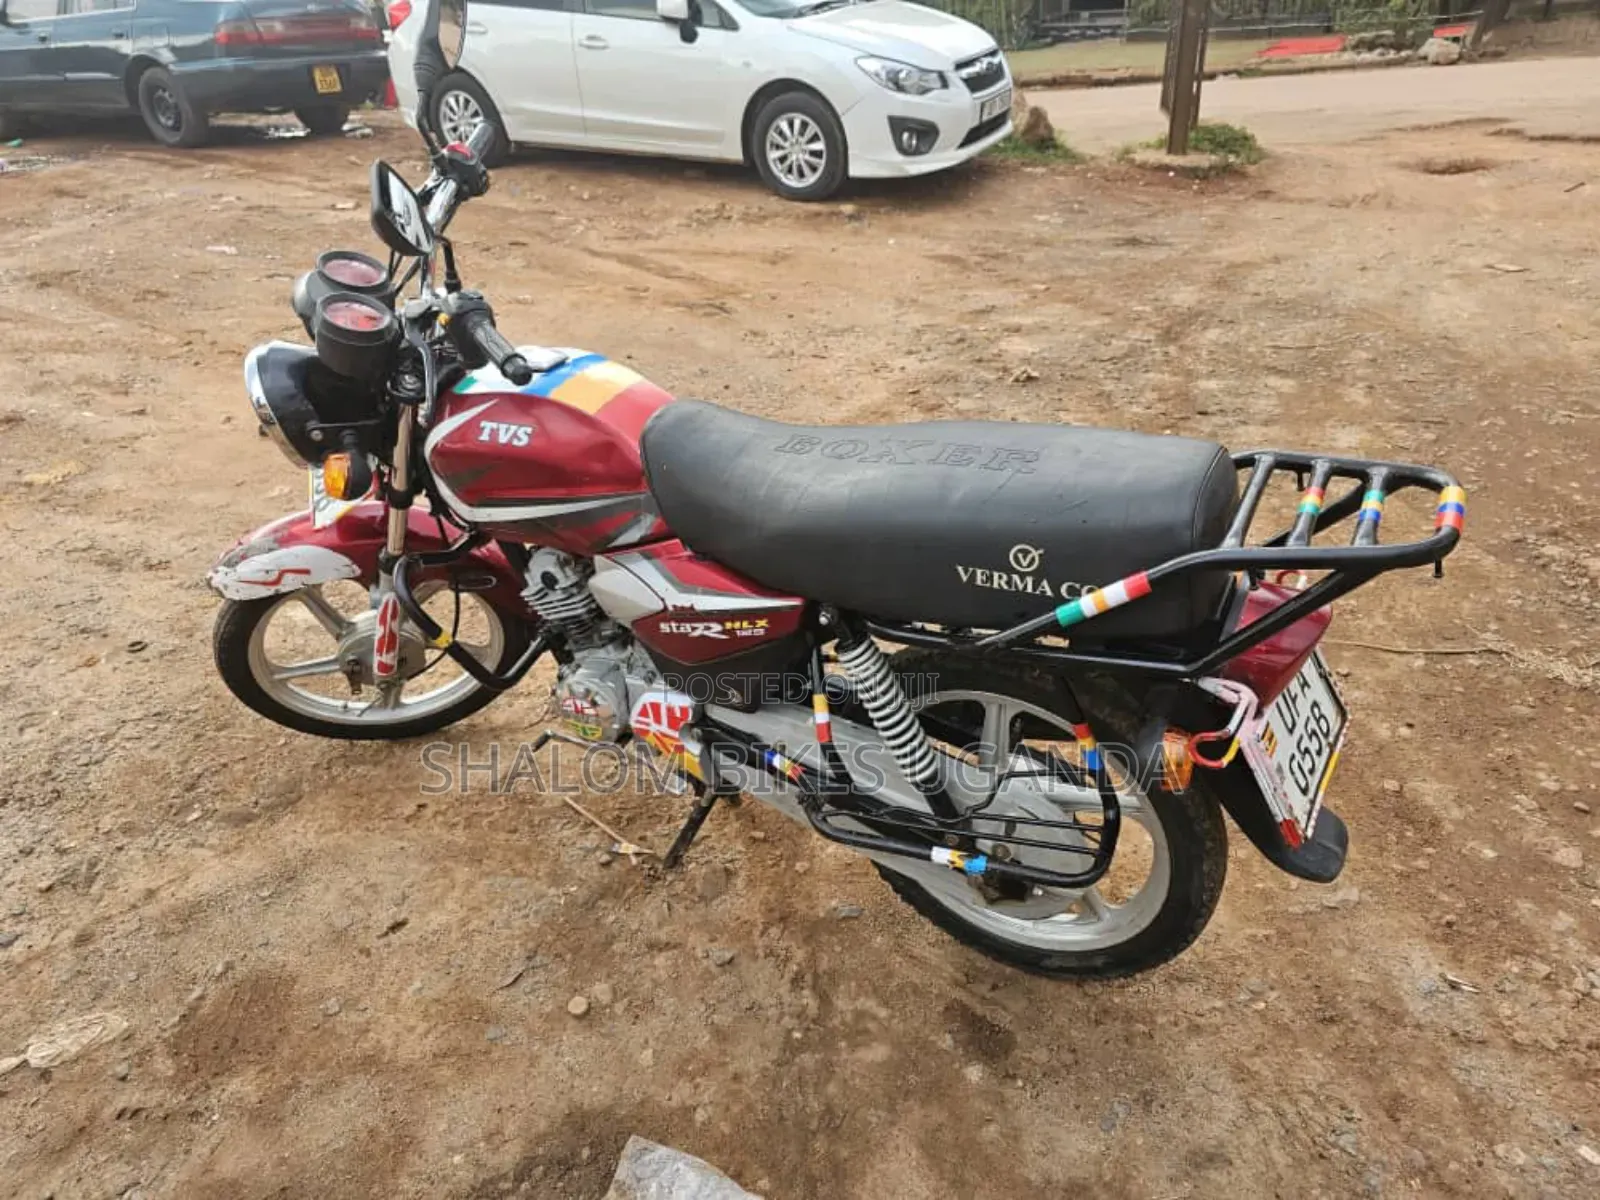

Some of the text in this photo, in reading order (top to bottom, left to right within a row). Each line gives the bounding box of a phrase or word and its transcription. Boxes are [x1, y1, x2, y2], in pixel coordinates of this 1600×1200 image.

[477, 420, 534, 448] TVS
[773, 434, 1041, 475] BOXER
[955, 564, 1054, 597] VERMA
[723, 618, 769, 630] HLX
